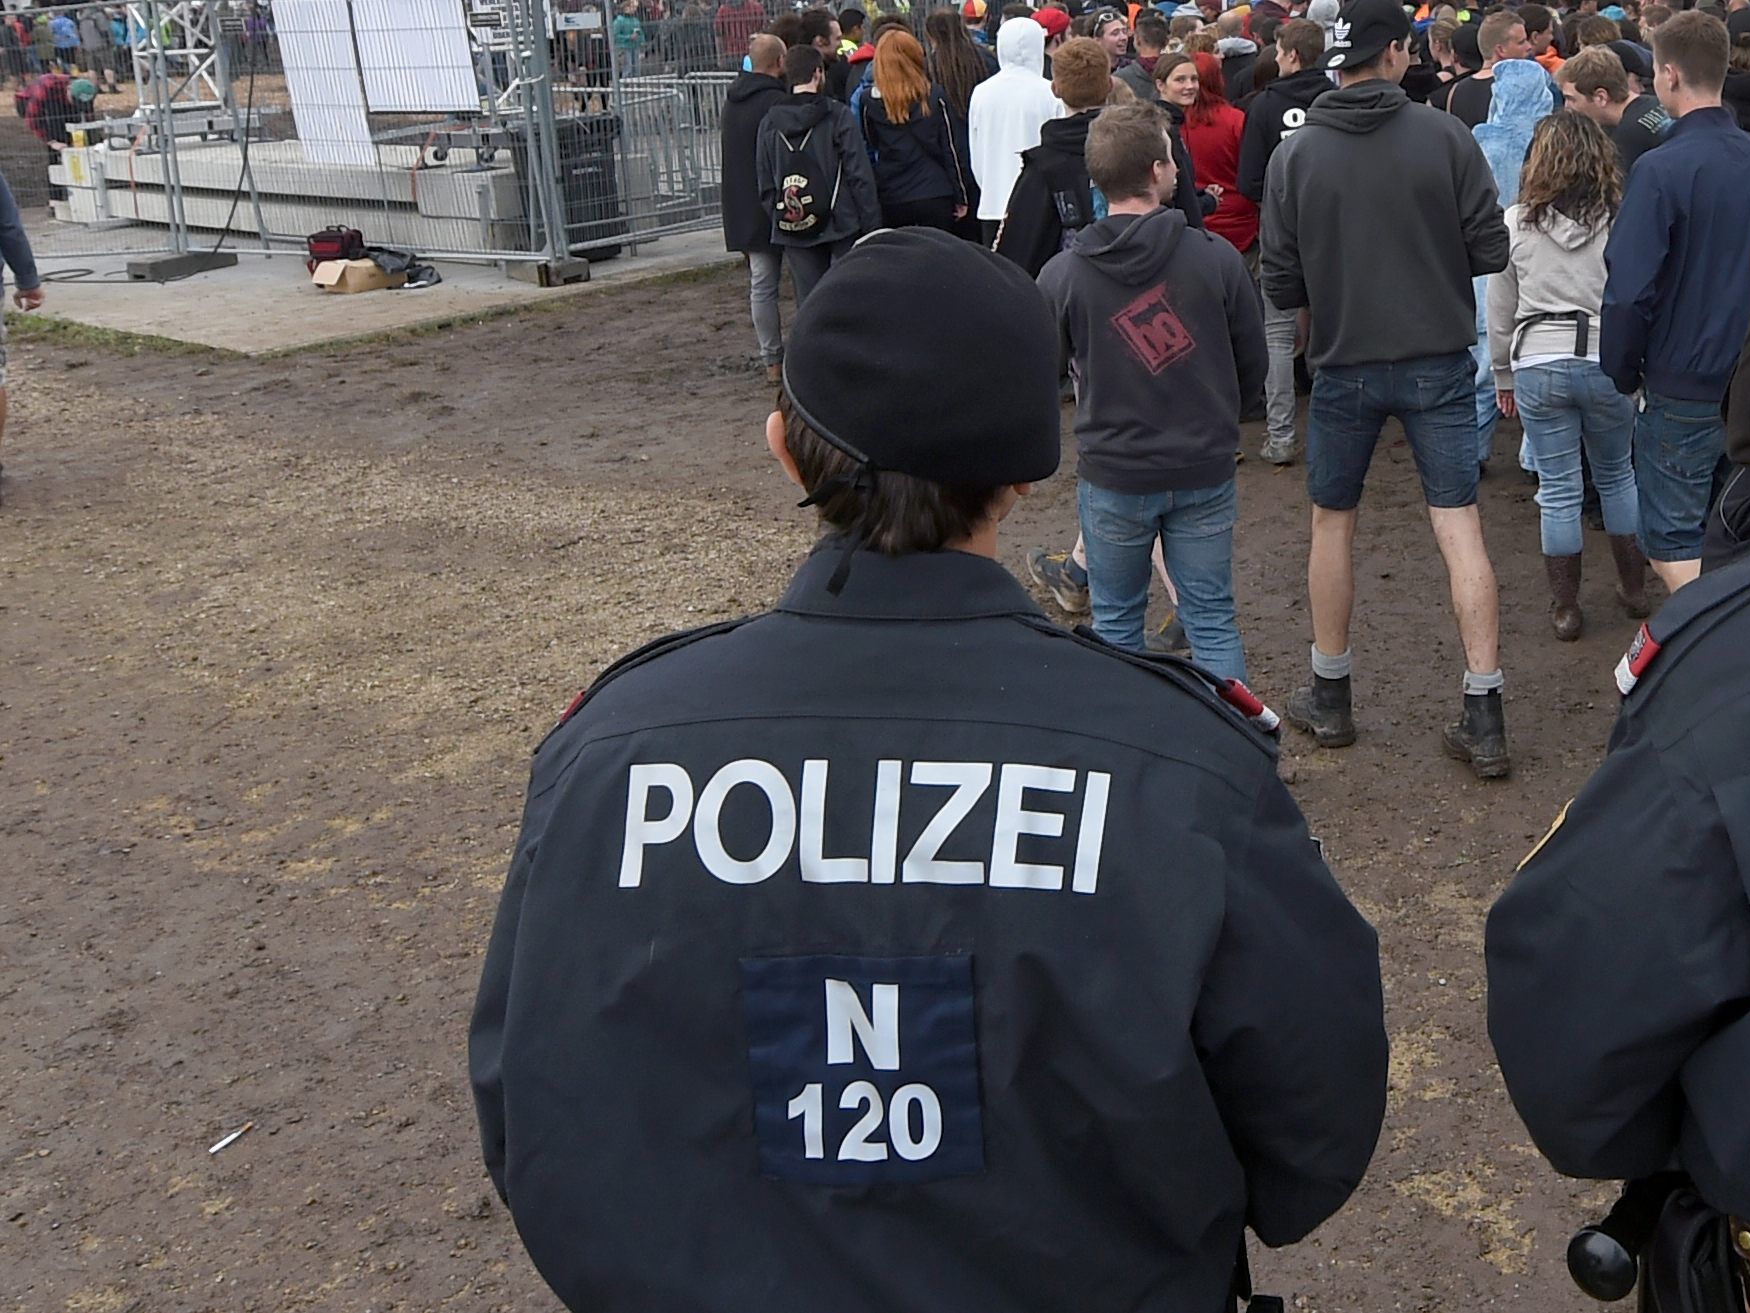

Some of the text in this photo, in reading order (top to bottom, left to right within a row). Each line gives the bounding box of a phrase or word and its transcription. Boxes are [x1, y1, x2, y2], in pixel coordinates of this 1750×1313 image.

[619, 759, 1111, 894] POLIZEI
[825, 978, 900, 1070] N
[787, 1080, 942, 1161] 120
